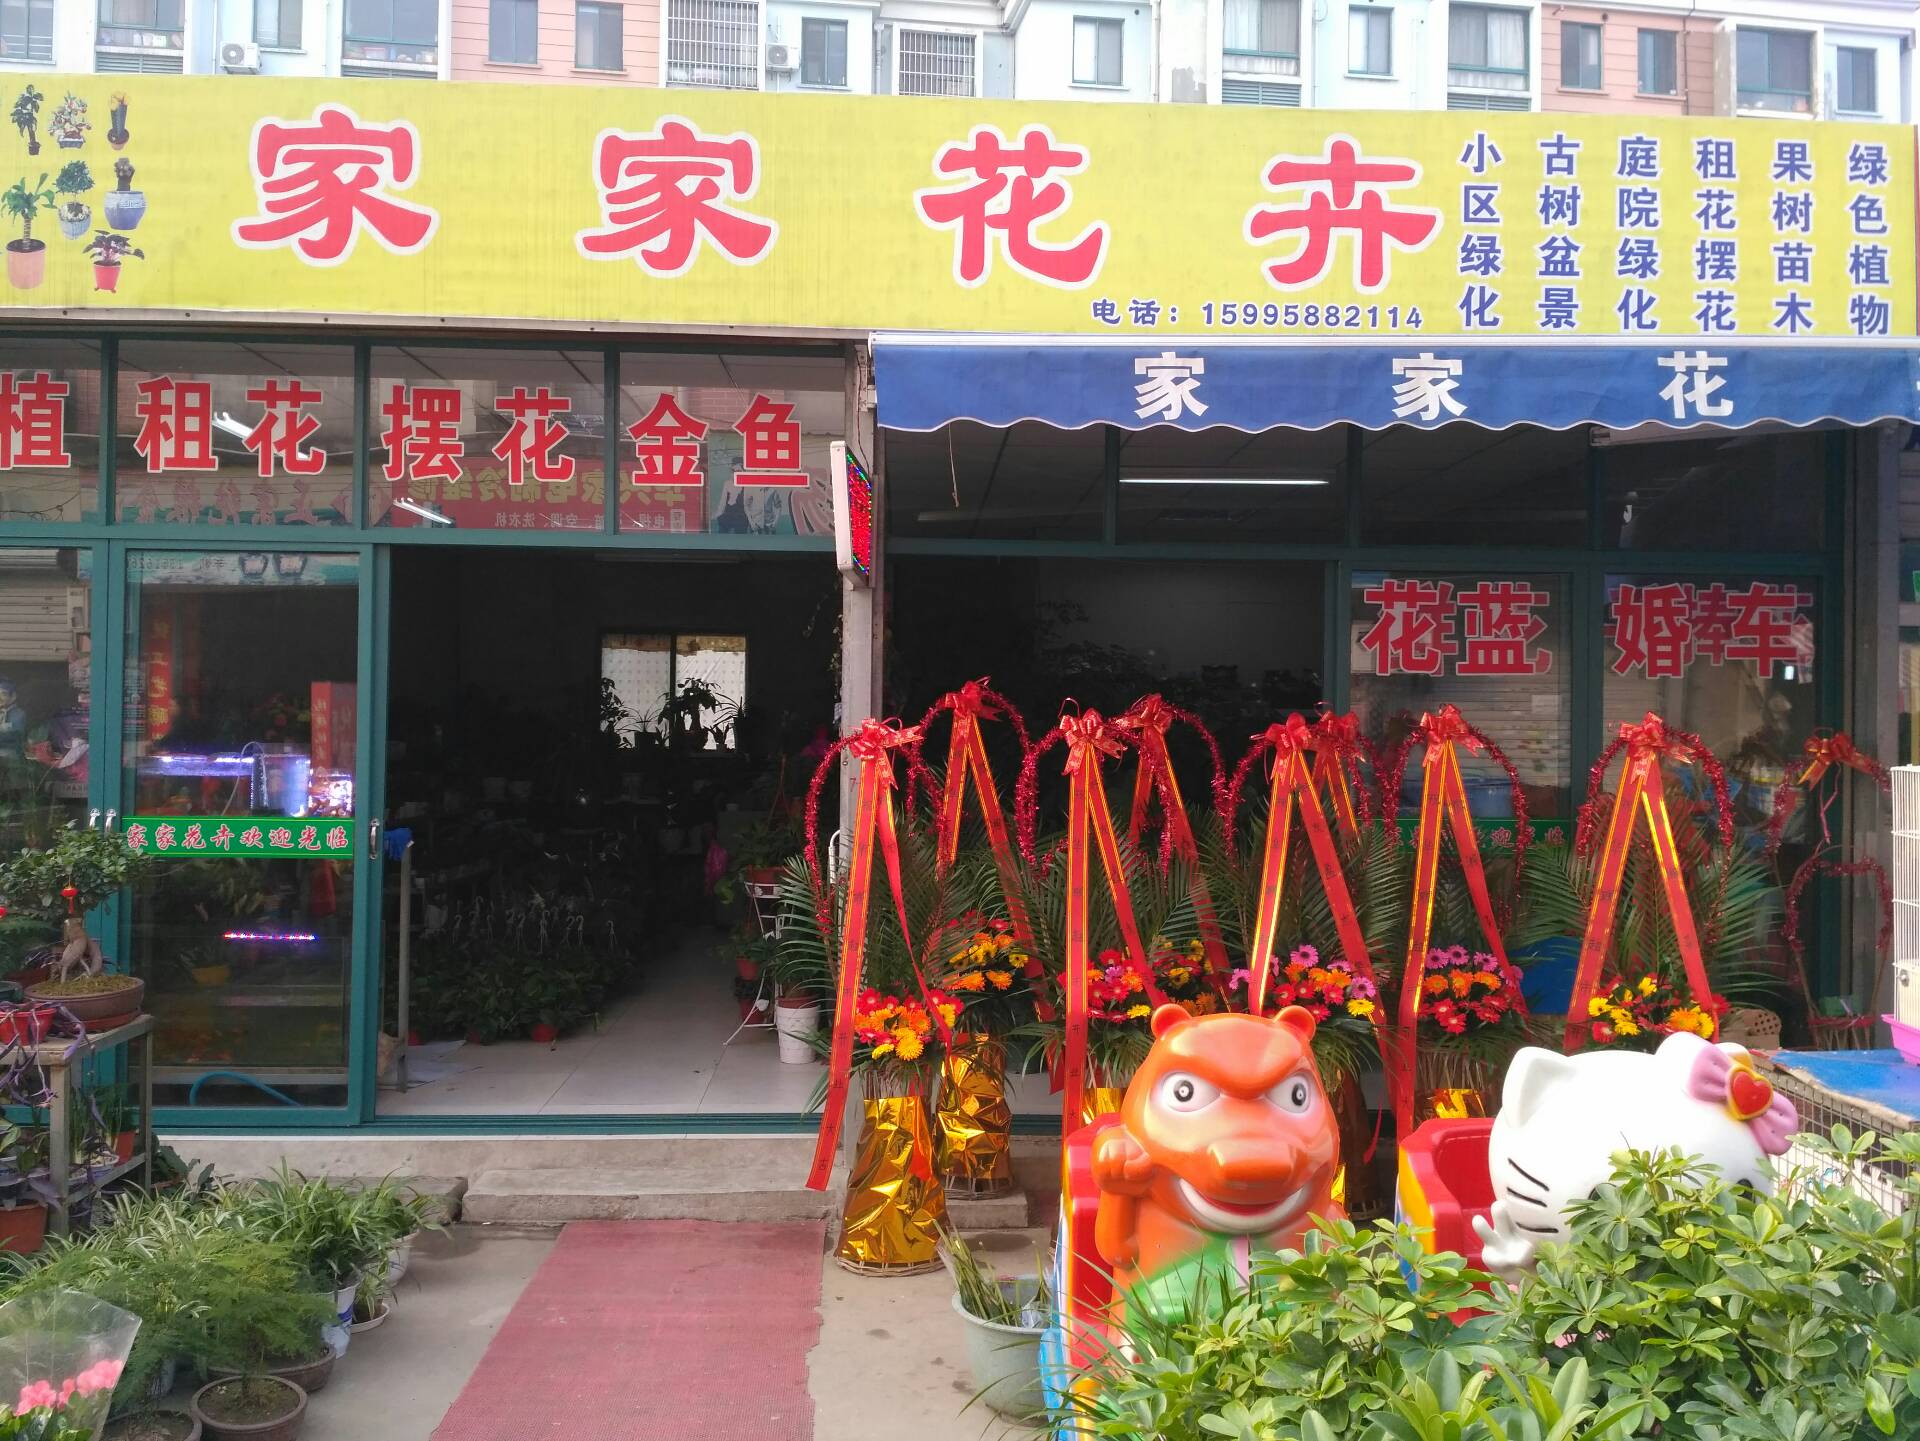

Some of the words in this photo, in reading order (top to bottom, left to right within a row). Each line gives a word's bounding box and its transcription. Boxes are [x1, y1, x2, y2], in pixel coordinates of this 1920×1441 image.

[238, 109, 1438, 288] 家家花卉
[1459, 133, 1502, 328] 小区绿化
[1538, 133, 1581, 330] 古树盆景
[1616, 136, 1660, 331] 庭院绿化
[1694, 139, 1737, 333] 租花摆花
[1772, 141, 1813, 334] 果树苗木
[1848, 143, 1890, 335] 绿色植物
[1133, 350, 1734, 420] 家家花
[1202, 303, 1423, 328] 15995882114
[0, 372, 70, 469] 植
[135, 377, 326, 476] 租花
[382, 384, 576, 485] 摆花
[627, 393, 810, 487] 金鱼
[126, 823, 349, 851] 家家花卉欢迎光临
